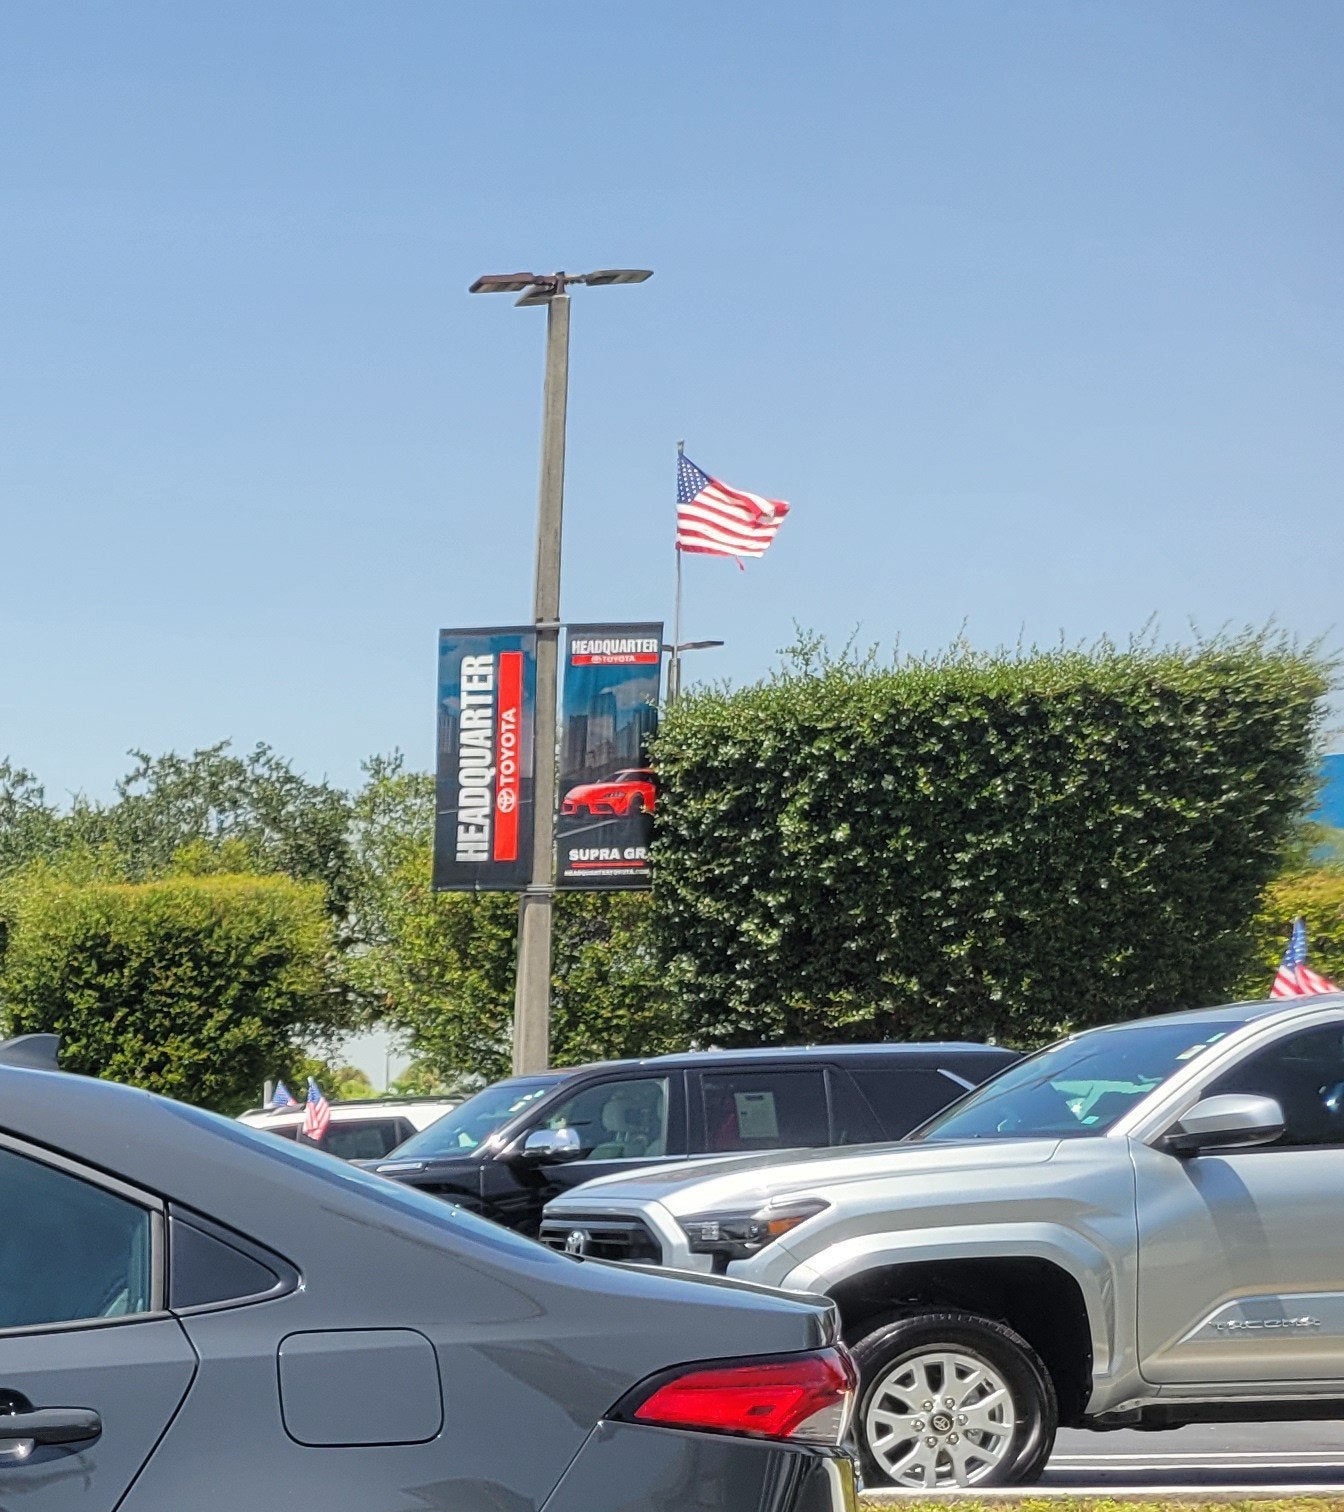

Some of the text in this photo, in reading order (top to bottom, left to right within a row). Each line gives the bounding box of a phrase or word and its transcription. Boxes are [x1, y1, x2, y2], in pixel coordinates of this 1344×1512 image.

[571, 638, 659, 656] HEADQUARTER
[602, 654, 636, 664] TOYOTA
[499, 707, 517, 787] TOYOTA
[455, 652, 496, 862] HEADQUARTER
[568, 846, 647, 861] SUPRA GR
